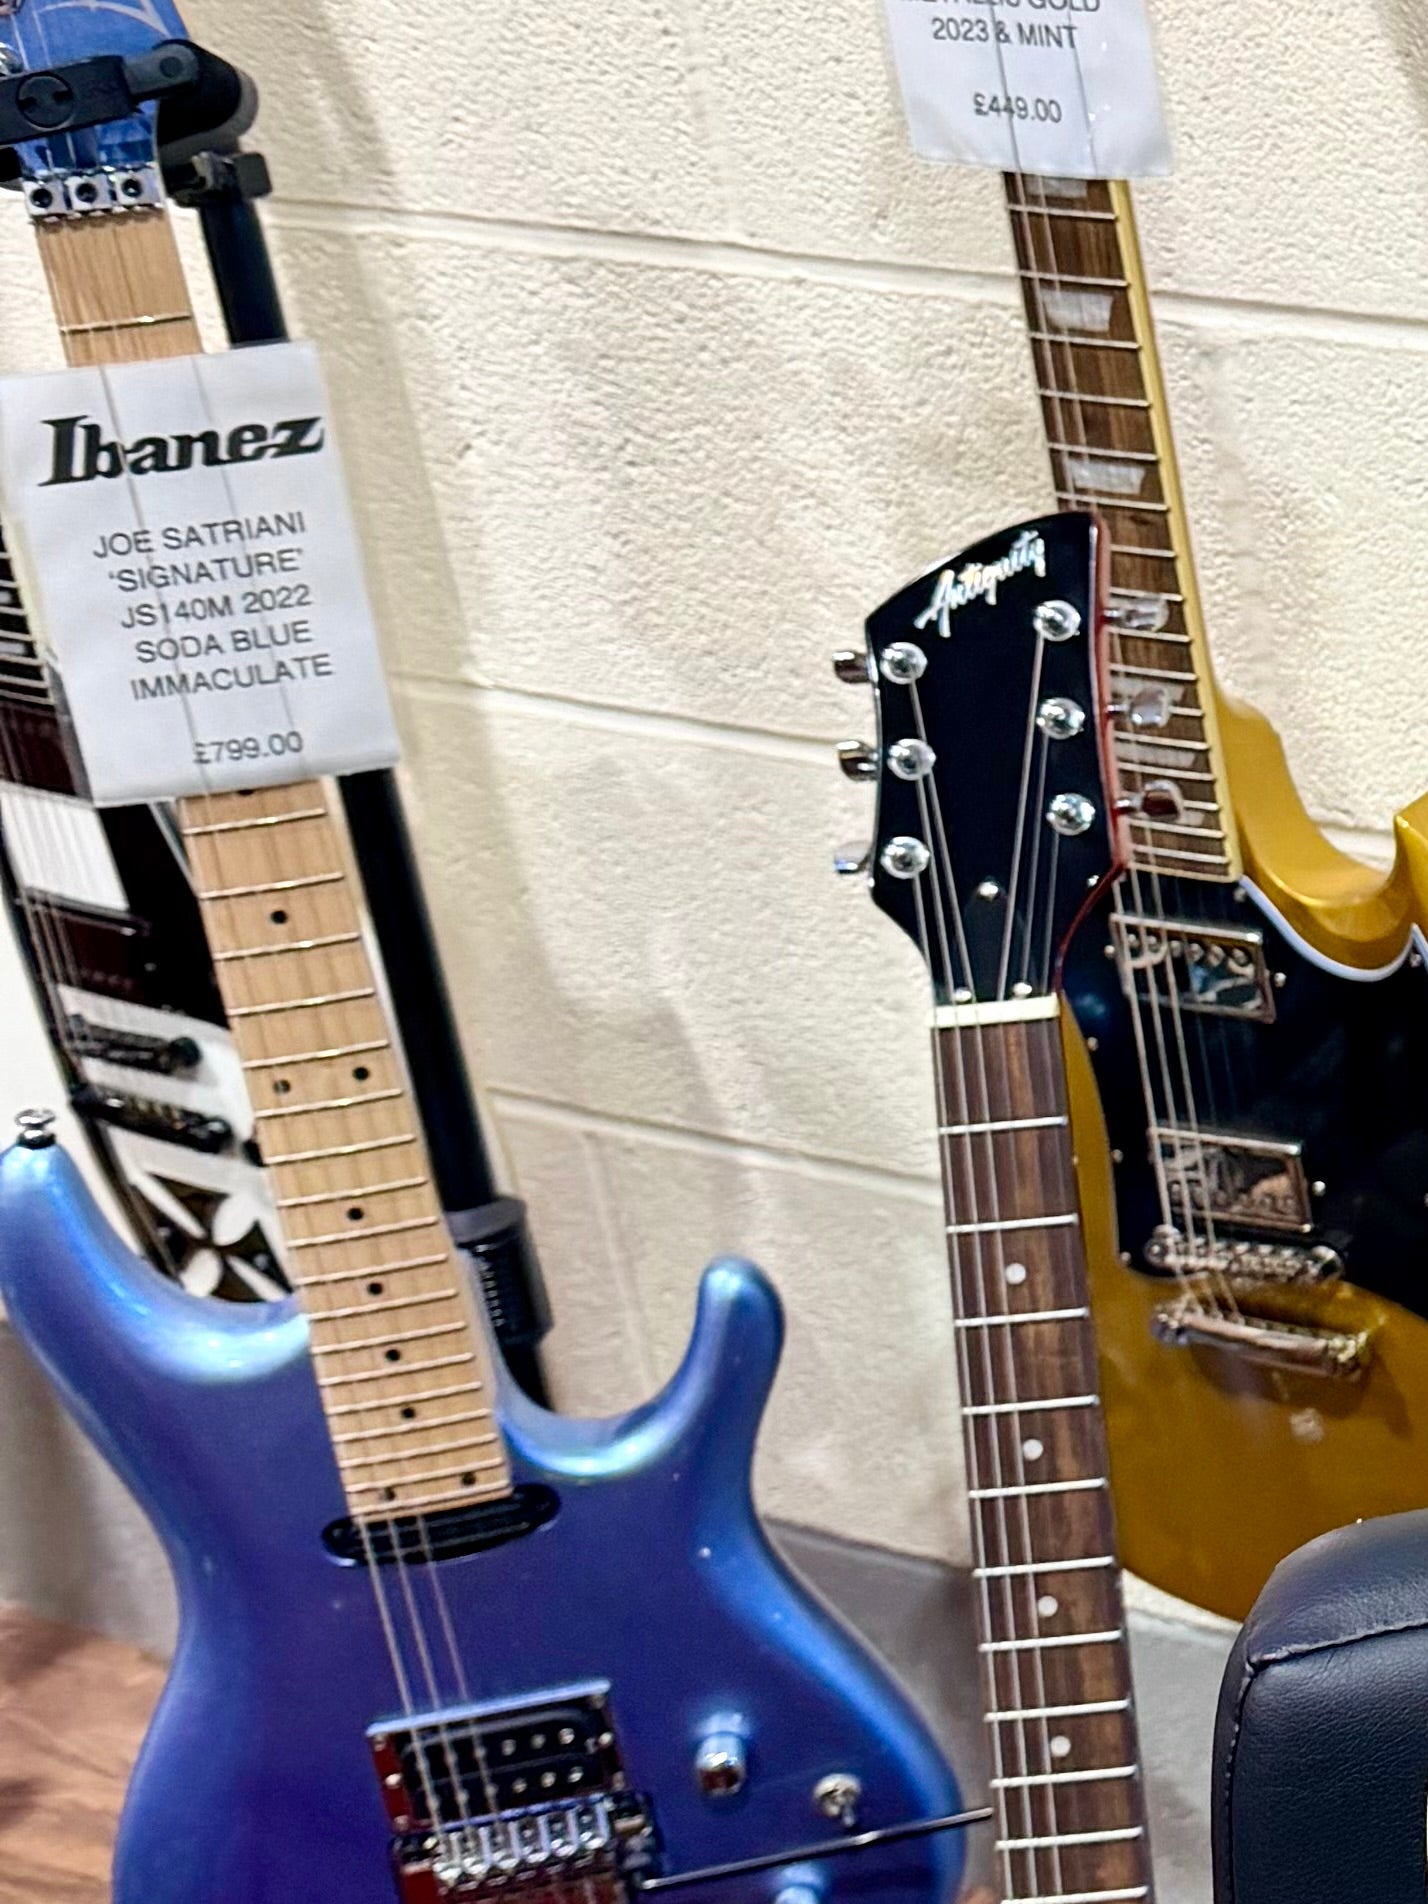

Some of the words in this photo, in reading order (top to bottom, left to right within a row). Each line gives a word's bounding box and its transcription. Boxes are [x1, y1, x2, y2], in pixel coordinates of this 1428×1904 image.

[931, 17, 989, 42] 2023
[995, 20, 1011, 44] &
[1018, 22, 1078, 48] MINT
[972, 92, 1062, 123] £449.00
[37, 415, 326, 487] Ibanez
[93, 529, 155, 559] JOE
[162, 511, 306, 550] SATRIANI
[121, 595, 234, 628] JS140M
[242, 584, 312, 614] 2022
[913, 530, 1046, 638] Antiquity
[135, 634, 225, 663] SODA
[230, 620, 313, 652] BLUE
[130, 653, 333, 701] IMMACULATE
[193, 730, 303, 764] £799.00
